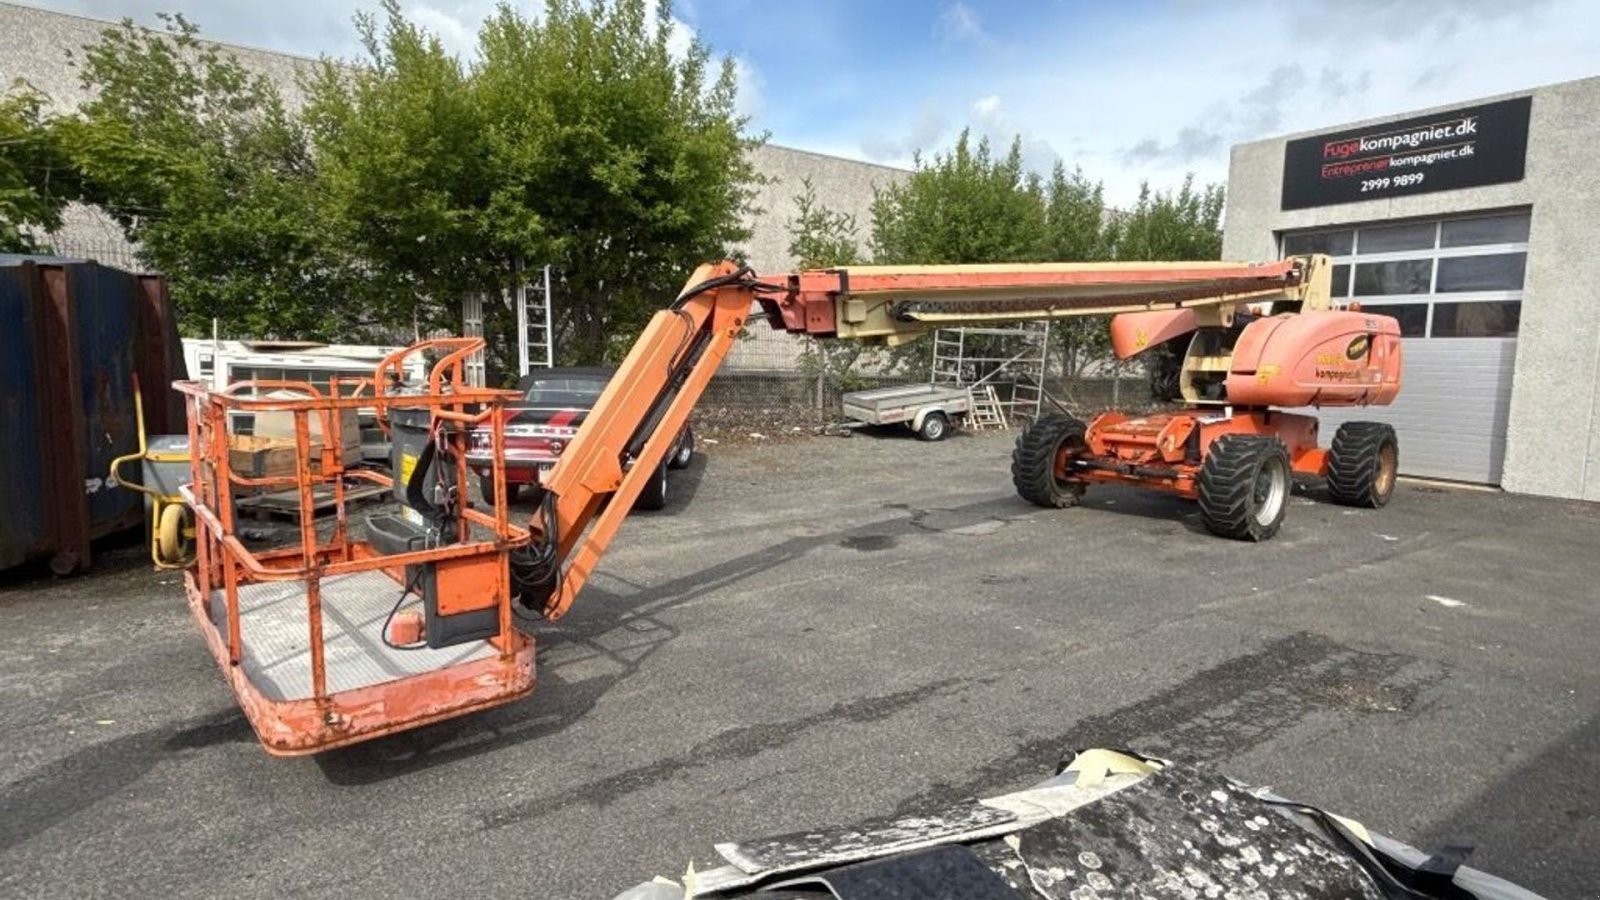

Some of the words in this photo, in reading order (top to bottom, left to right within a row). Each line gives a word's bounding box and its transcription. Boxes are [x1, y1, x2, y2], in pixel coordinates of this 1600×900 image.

[1323, 119, 1477, 157] Fugekompagniet.dk
[1360, 178, 1390, 192] 2999
[1393, 172, 1424, 187] 9899
